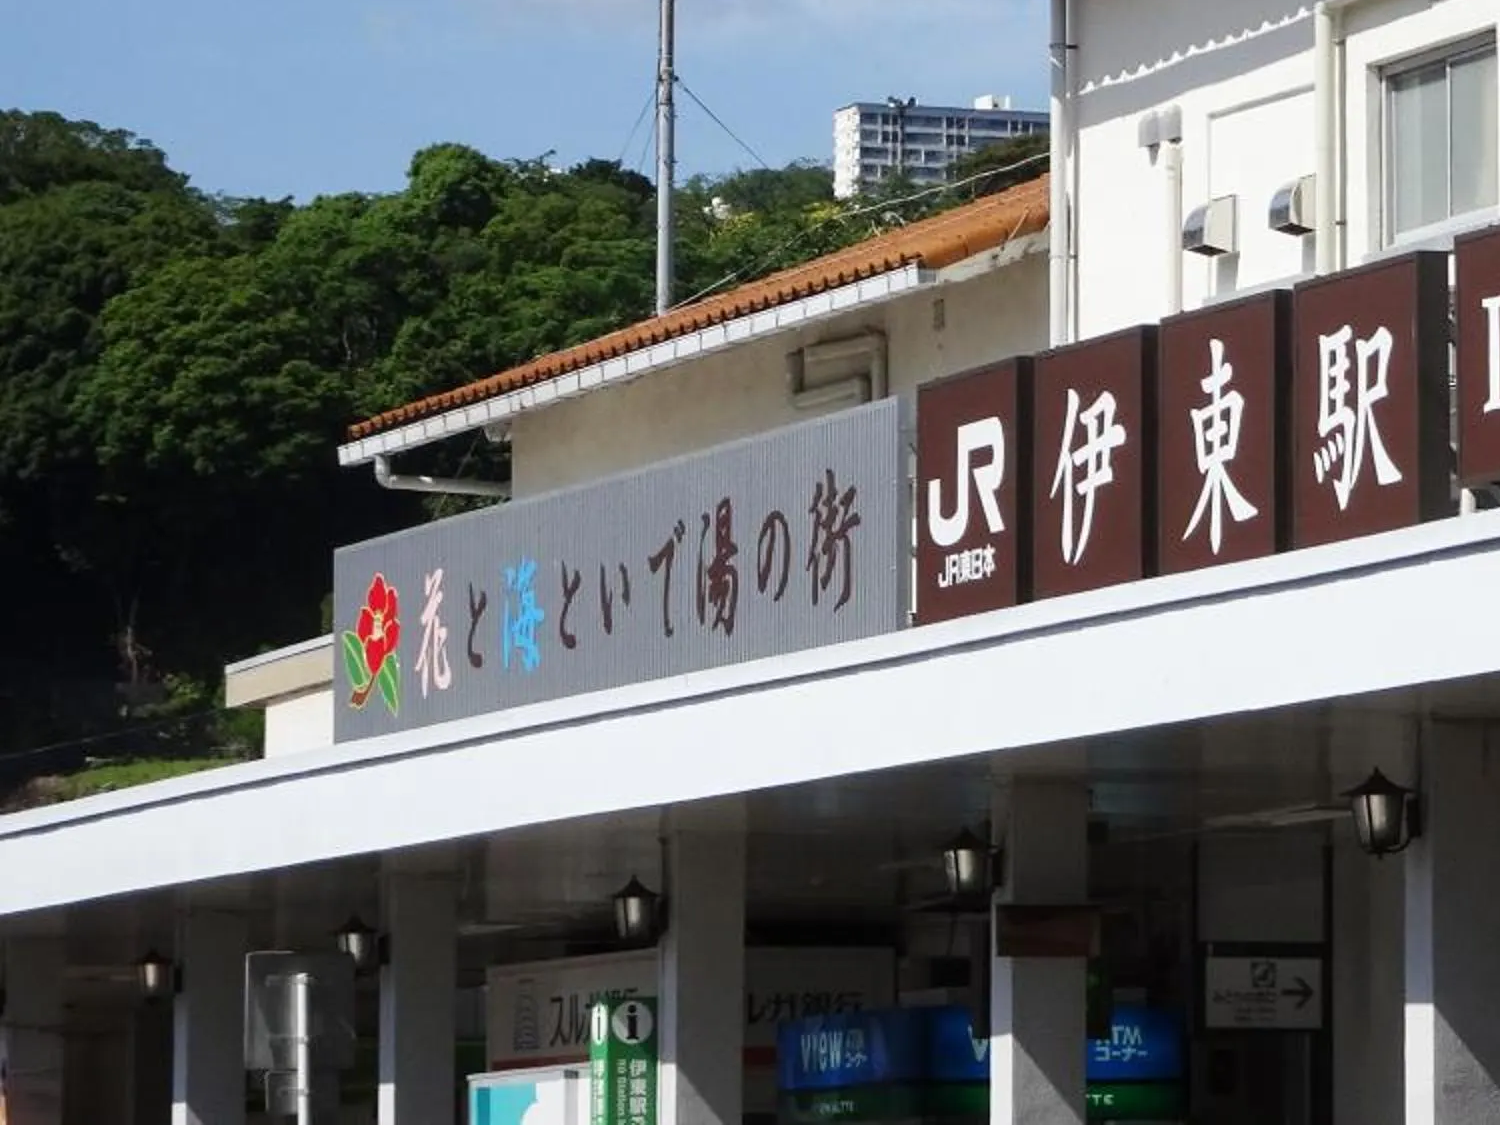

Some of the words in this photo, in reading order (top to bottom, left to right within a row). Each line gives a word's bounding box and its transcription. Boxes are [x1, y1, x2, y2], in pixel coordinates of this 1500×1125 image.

[928, 416, 1005, 546] JR
[1050, 323, 1404, 566] 伊東駅
[414, 467, 861, 700] 花と海といで湯の街
[938, 543, 996, 588] JR東日本
[1094, 1045, 1149, 1062] コーナー
[1095, 1024, 1143, 1047] TM
